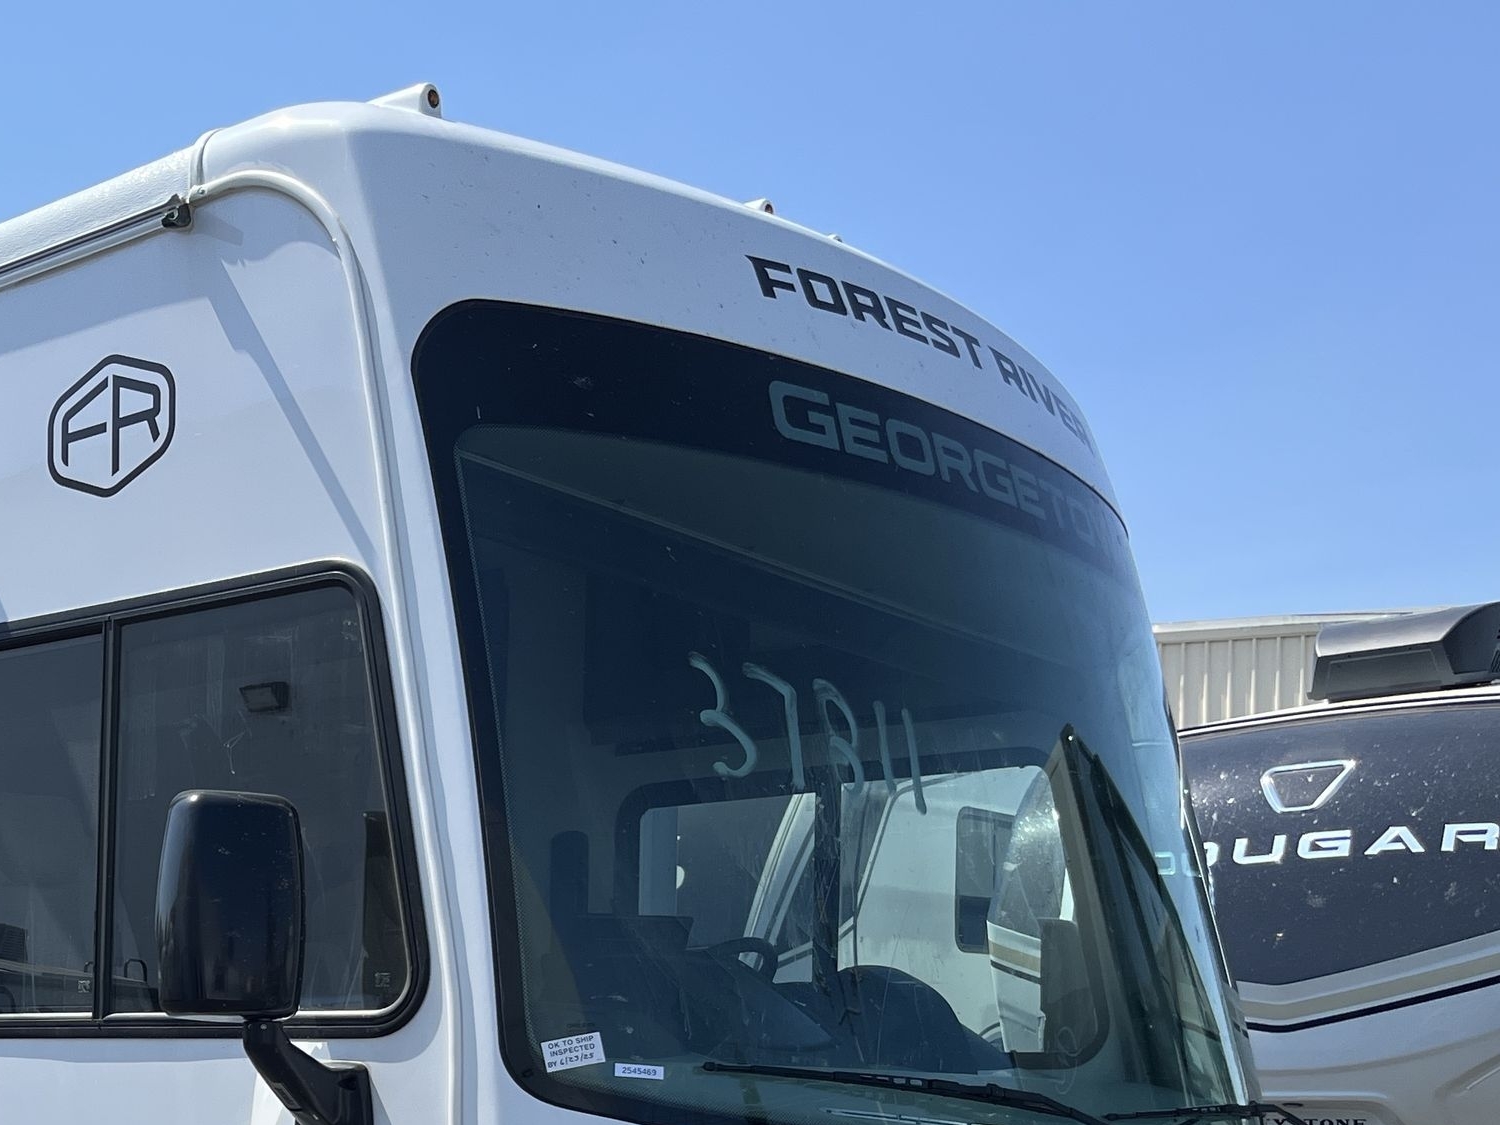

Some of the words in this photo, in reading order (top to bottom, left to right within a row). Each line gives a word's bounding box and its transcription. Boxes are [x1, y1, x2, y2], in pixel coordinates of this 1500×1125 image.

[746, 255, 983, 370] FOREST
[547, 1042, 560, 1050] OK
[562, 1039, 574, 1047] TO
[575, 1035, 594, 1044] SHIP
[550, 1043, 595, 1057] INSPECTED
[547, 1060, 557, 1069] BY
[621, 1066, 657, 1076] 2545469
